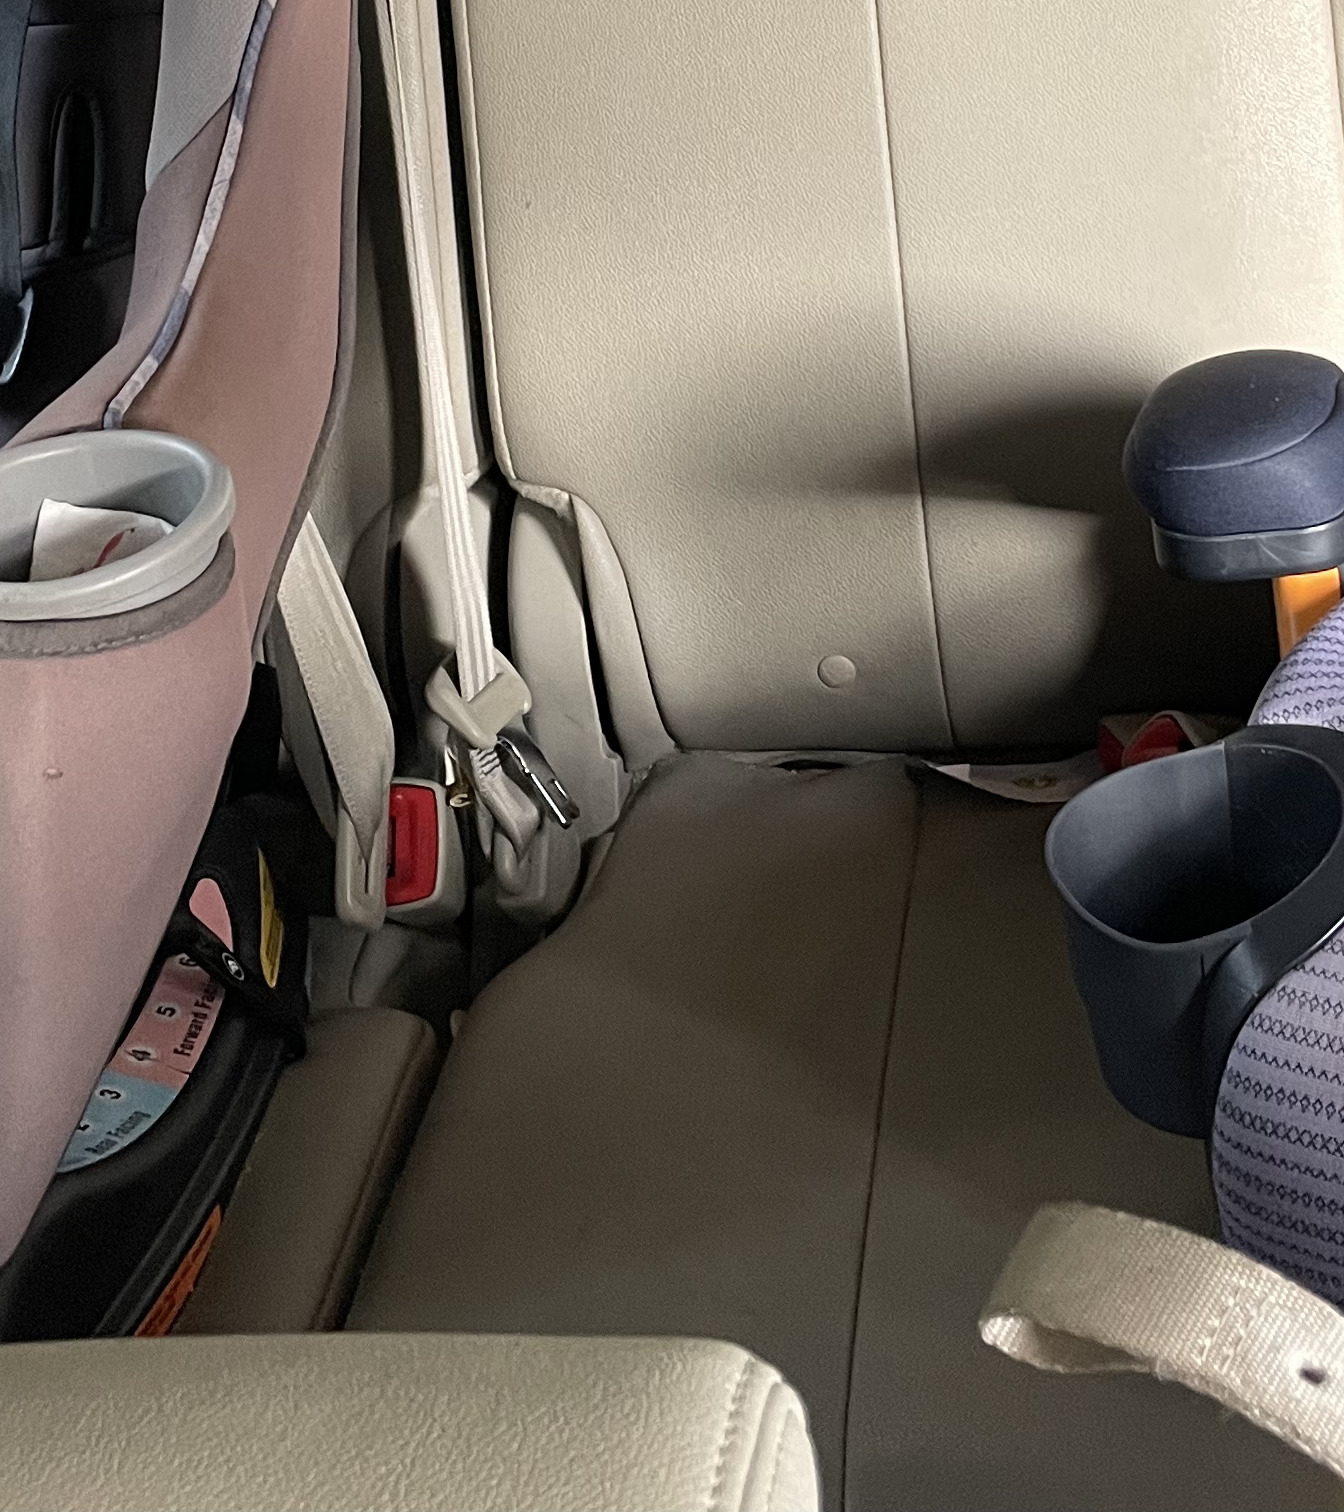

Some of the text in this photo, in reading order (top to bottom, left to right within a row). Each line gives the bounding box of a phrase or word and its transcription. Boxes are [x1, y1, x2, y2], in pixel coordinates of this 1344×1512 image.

[156, 1005, 176, 1018] 5
[173, 1011, 208, 1057] Forward
[99, 1089, 122, 1100] 3
